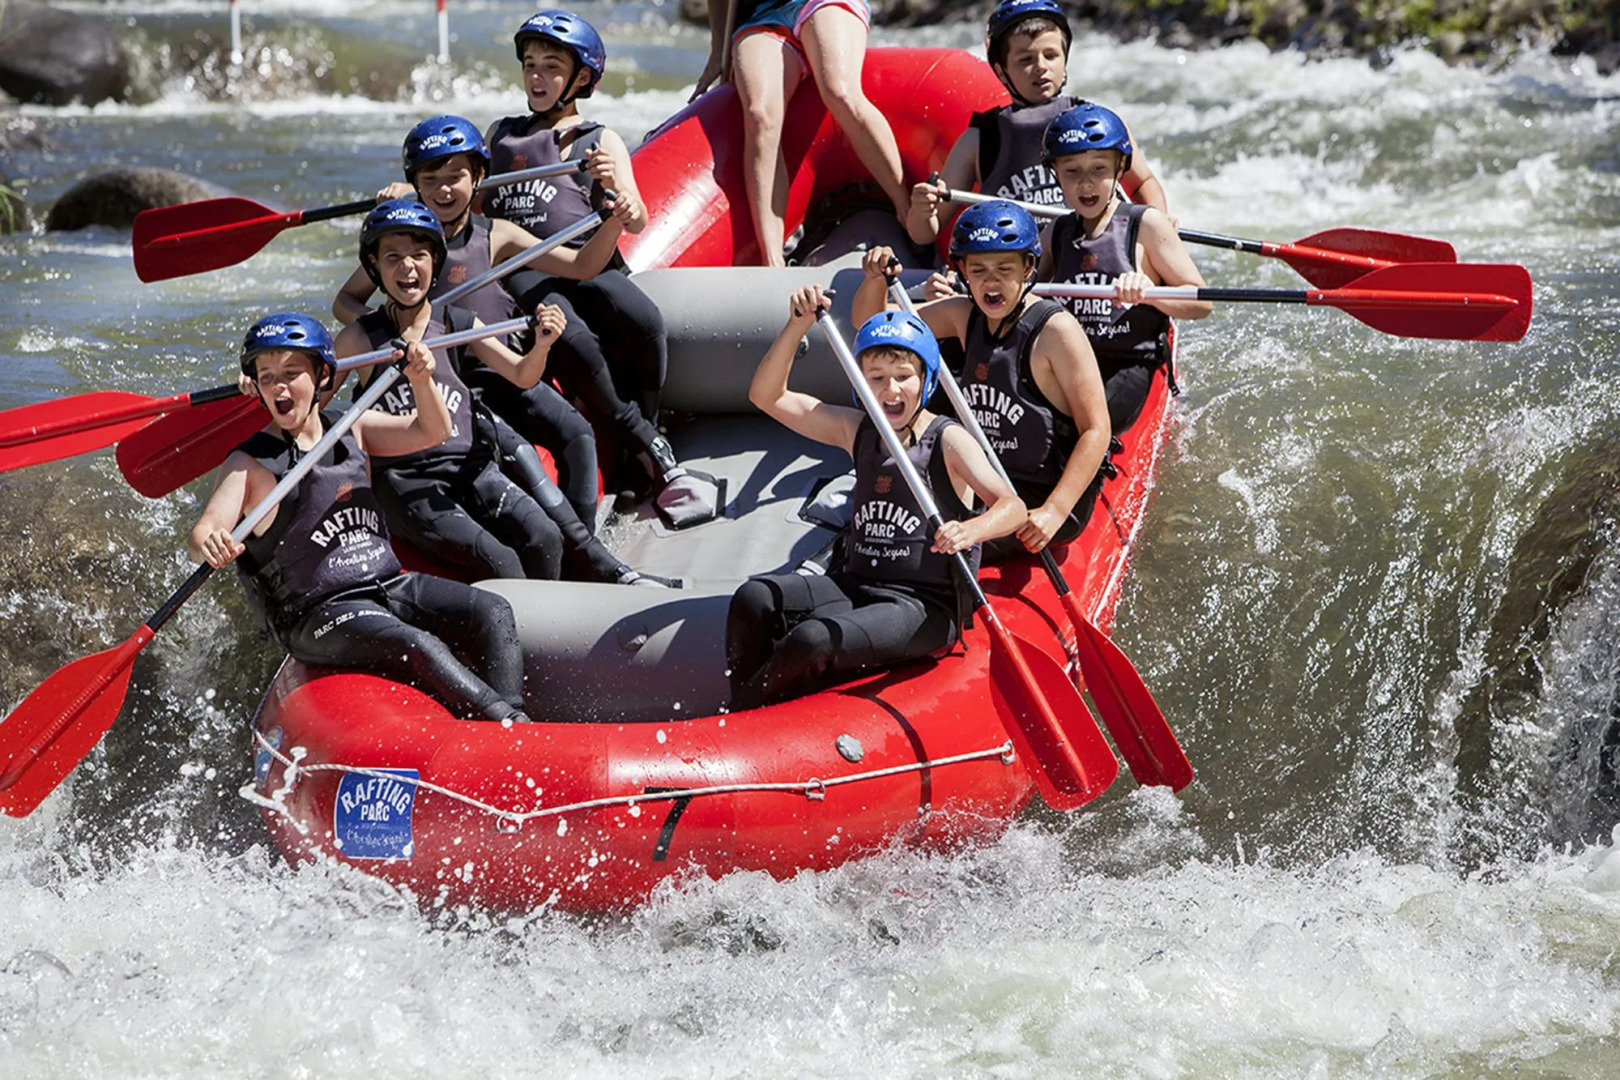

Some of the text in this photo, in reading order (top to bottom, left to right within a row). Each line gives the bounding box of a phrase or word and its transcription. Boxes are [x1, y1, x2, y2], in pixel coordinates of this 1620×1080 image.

[997, 164, 1056, 199] RAFT
[505, 195, 535, 210] PARC
[1074, 299, 1112, 315] PARC
[962, 383, 1025, 426] AFTING
[310, 507, 379, 547] RAFTING
[854, 500, 921, 535] RAFTING
[865, 523, 895, 538] PARC
[338, 527, 370, 547] PARC
[340, 778, 411, 815] RAFTING
[360, 801, 390, 821] PARC
